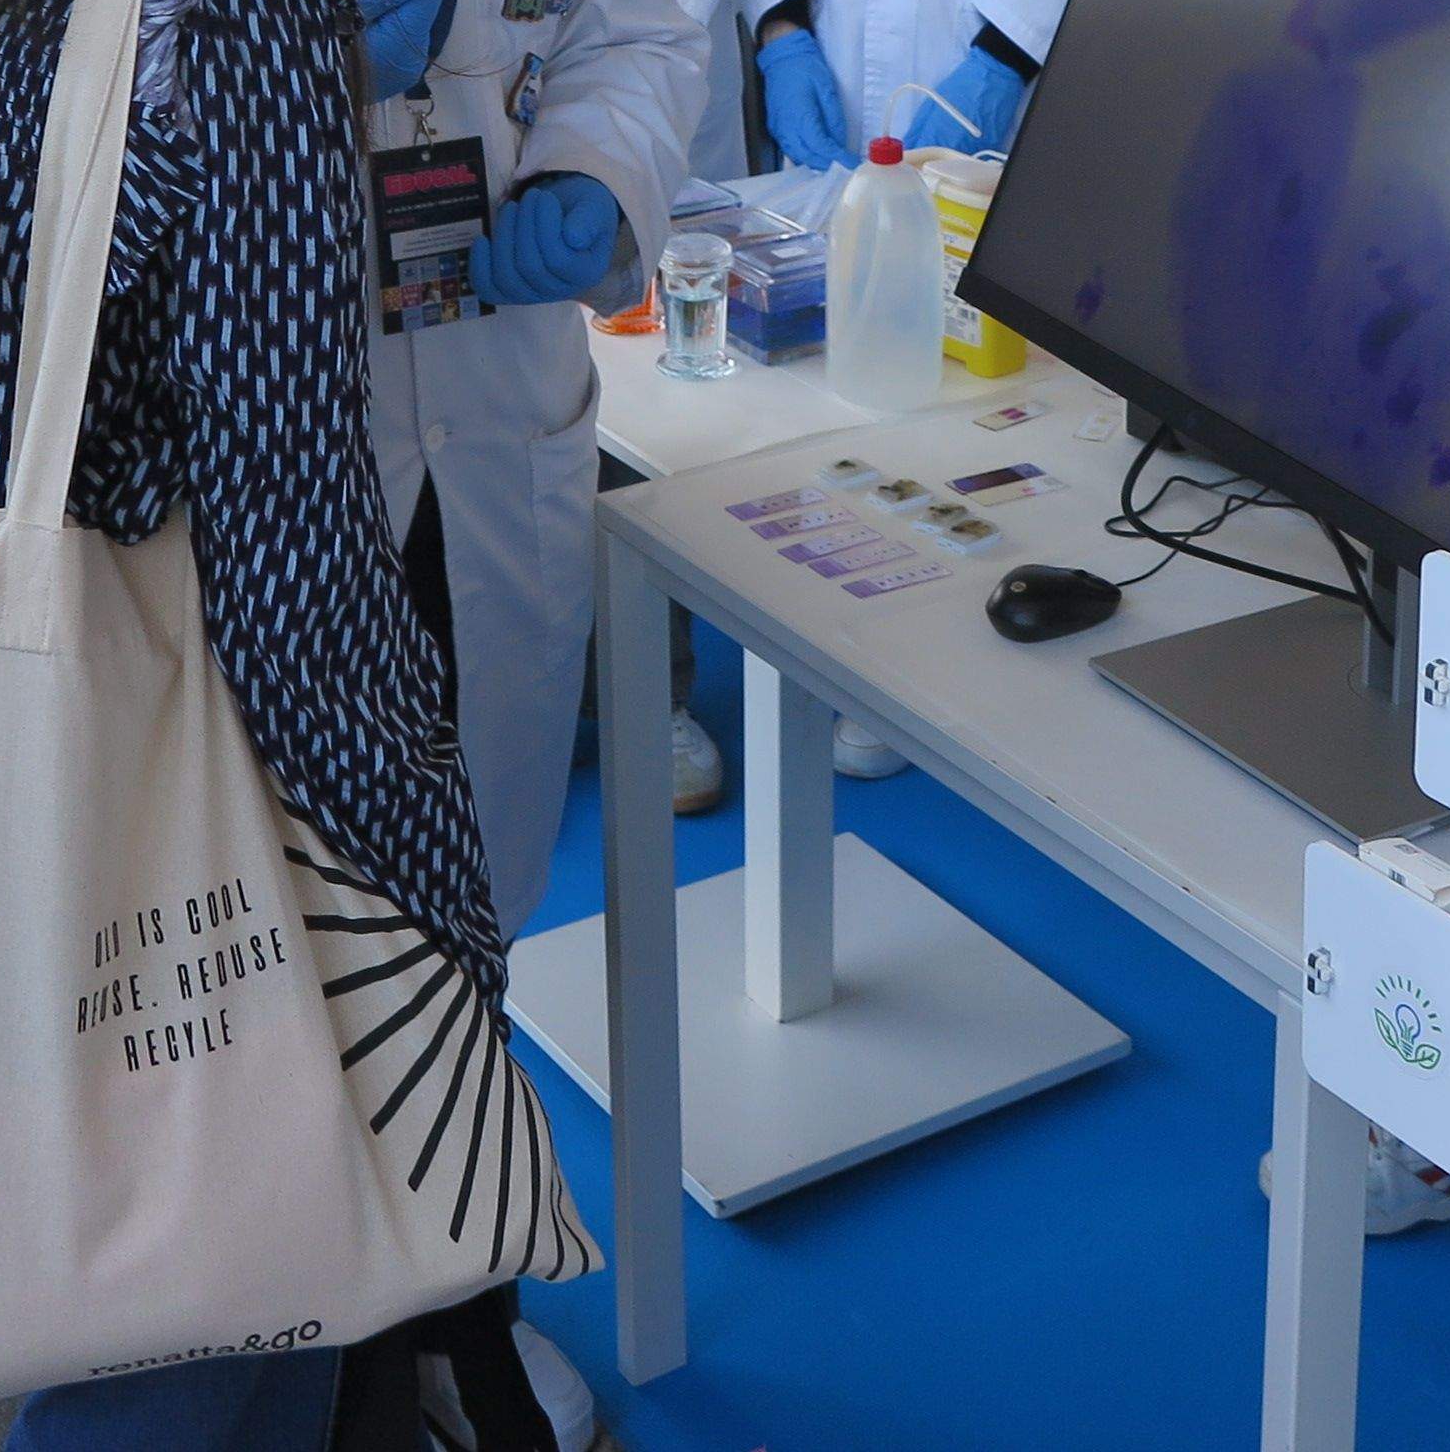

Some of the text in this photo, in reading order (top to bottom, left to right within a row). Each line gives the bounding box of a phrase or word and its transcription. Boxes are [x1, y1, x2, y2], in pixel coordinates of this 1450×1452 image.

[137, 908, 164, 947] IS
[185, 878, 252, 935] COOL
[176, 928, 286, 1000] REDUSE
[124, 1009, 232, 1072] RECYLE
